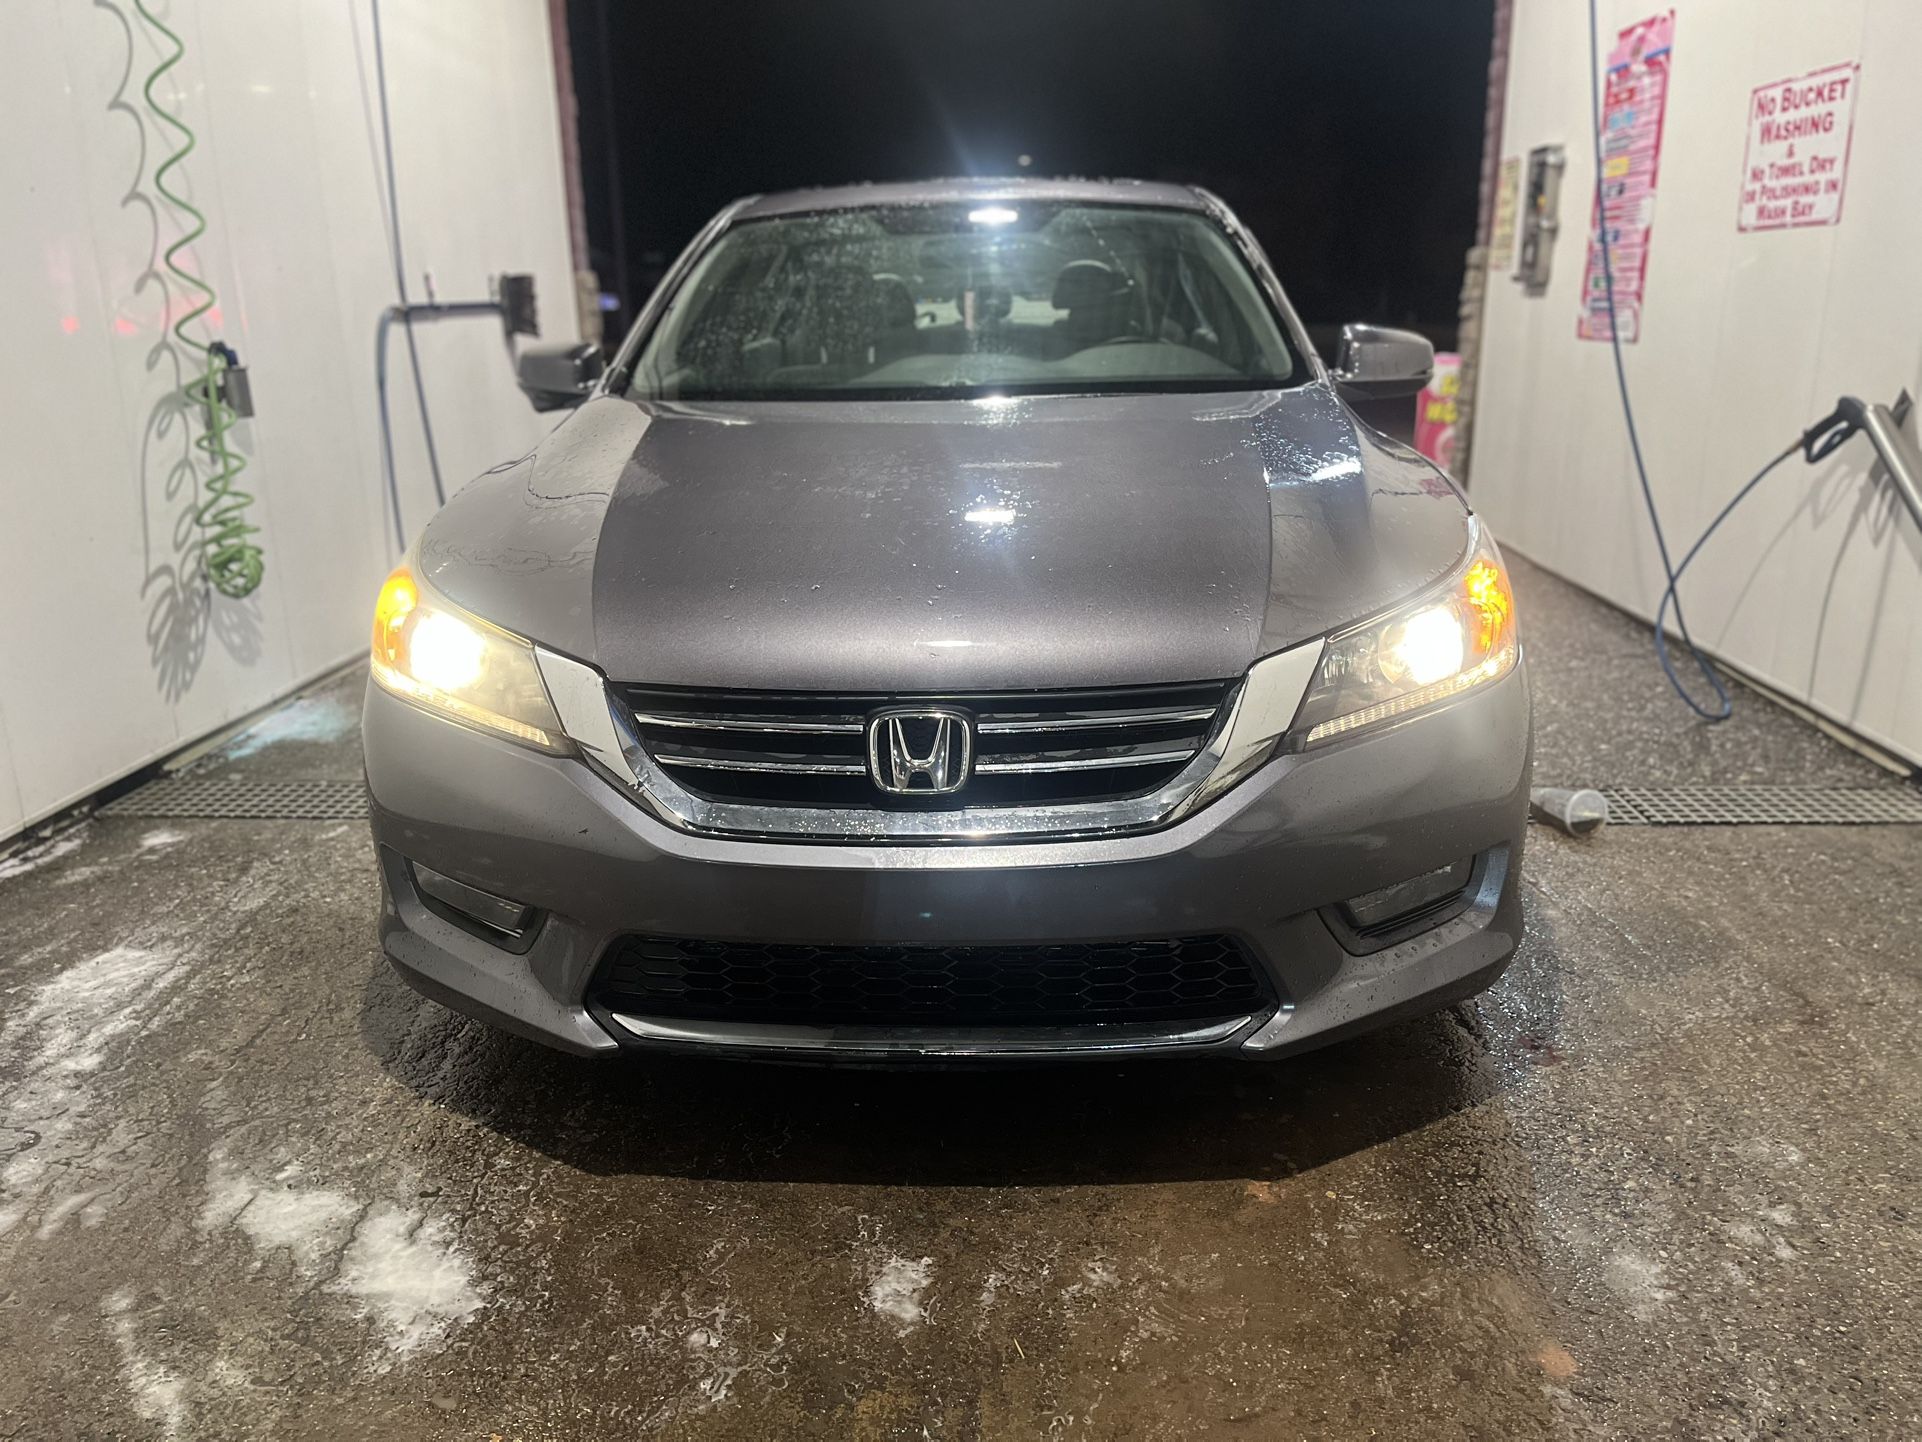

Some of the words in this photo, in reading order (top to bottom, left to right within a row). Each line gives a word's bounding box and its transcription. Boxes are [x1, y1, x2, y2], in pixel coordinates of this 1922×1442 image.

[1782, 79, 1850, 113] BUCKET
[1760, 113, 1834, 144] WASHING
[1786, 143, 1795, 158] &
[1768, 161, 1804, 181] TOWEL
[1809, 156, 1837, 175] DRY
[1760, 180, 1821, 201] POLISHING
[1824, 180, 1839, 195] IN
[1757, 204, 1787, 220] WASH
[1791, 201, 1815, 218] BAY
